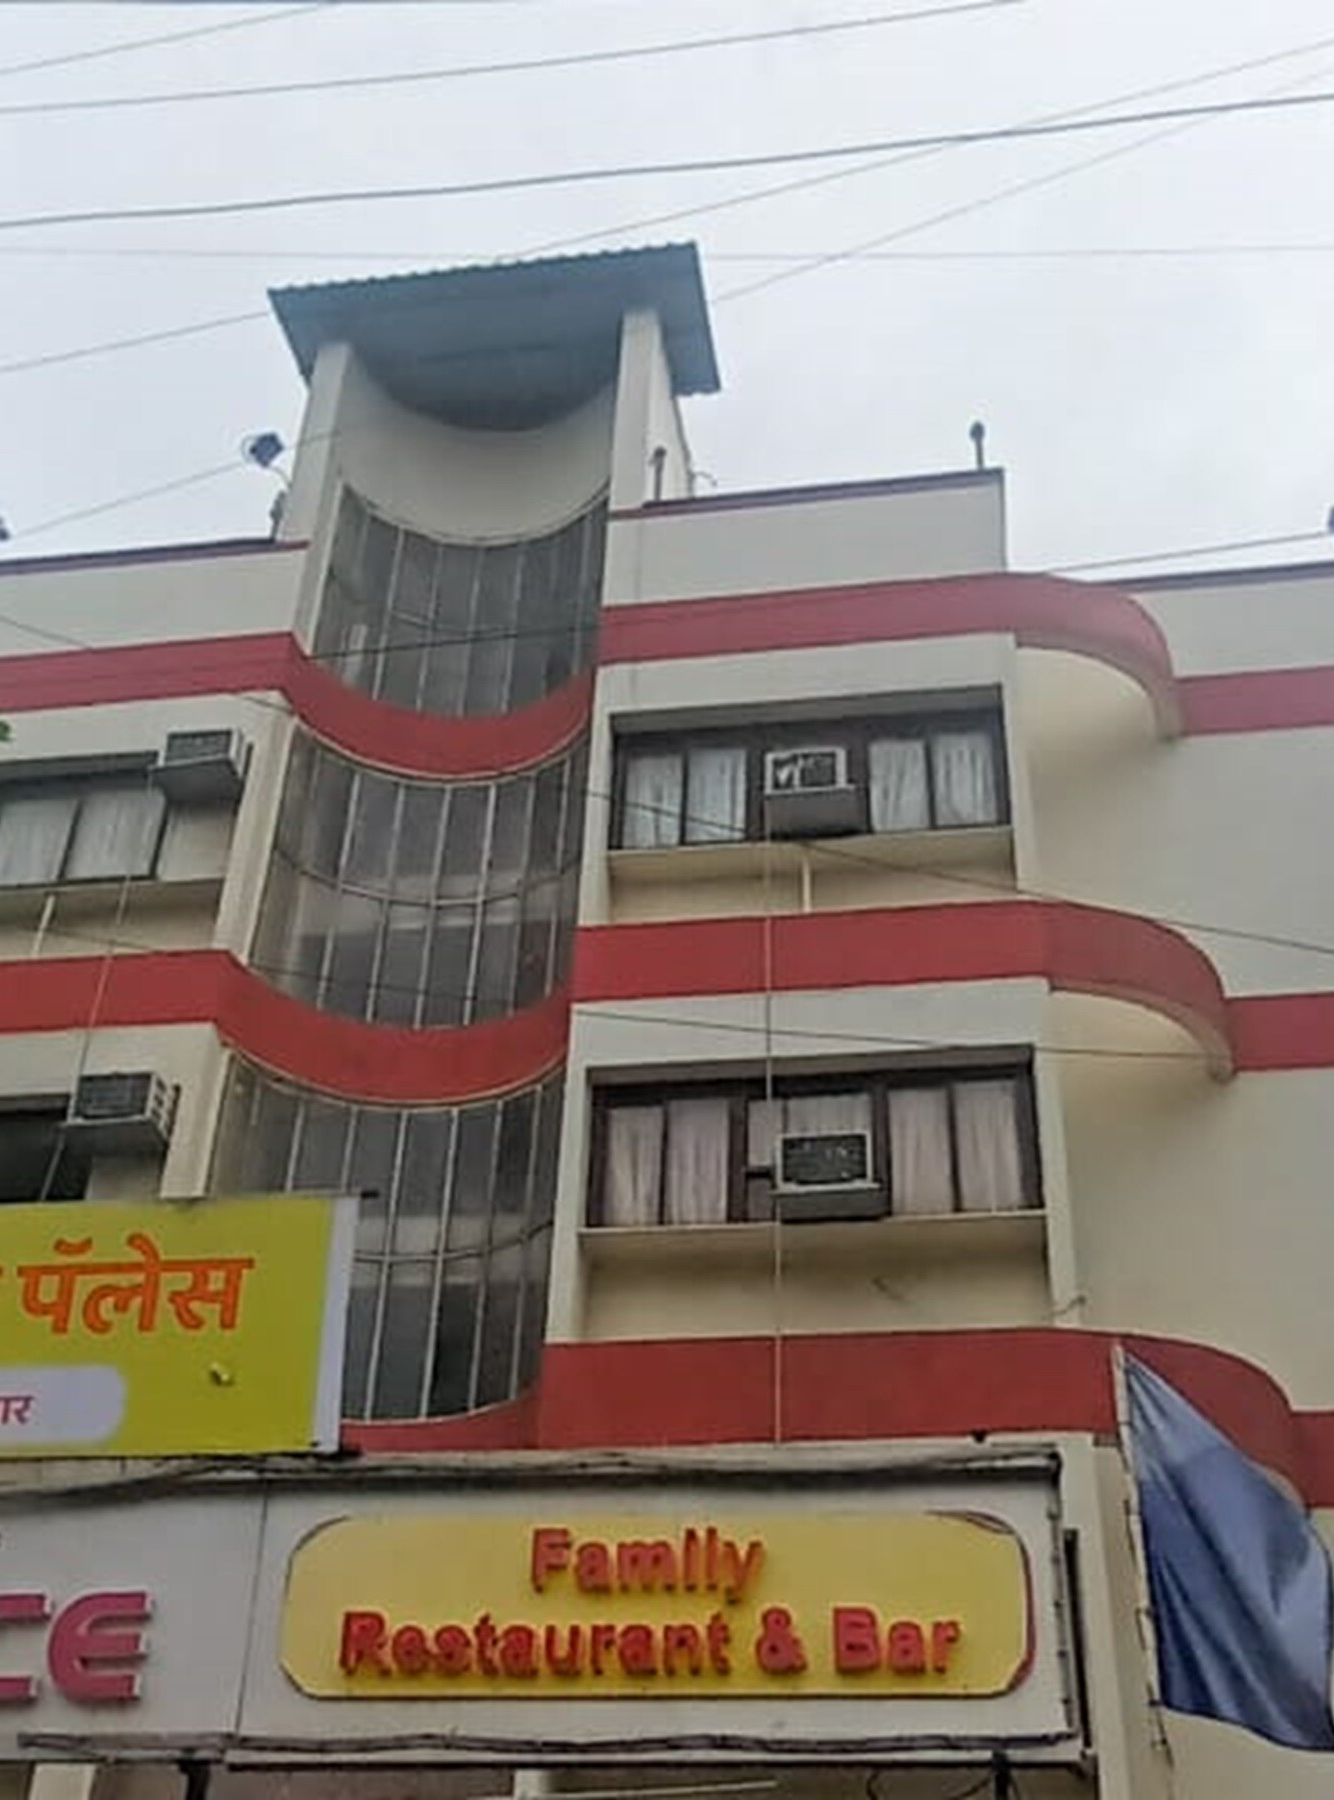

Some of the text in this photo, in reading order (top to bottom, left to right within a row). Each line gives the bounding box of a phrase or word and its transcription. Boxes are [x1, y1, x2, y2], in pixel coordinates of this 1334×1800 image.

[17, 1236, 255, 1336] पॅलेस
[529, 1525, 763, 1602] Family
[339, 1606, 961, 1678] Restaurant & Bar
